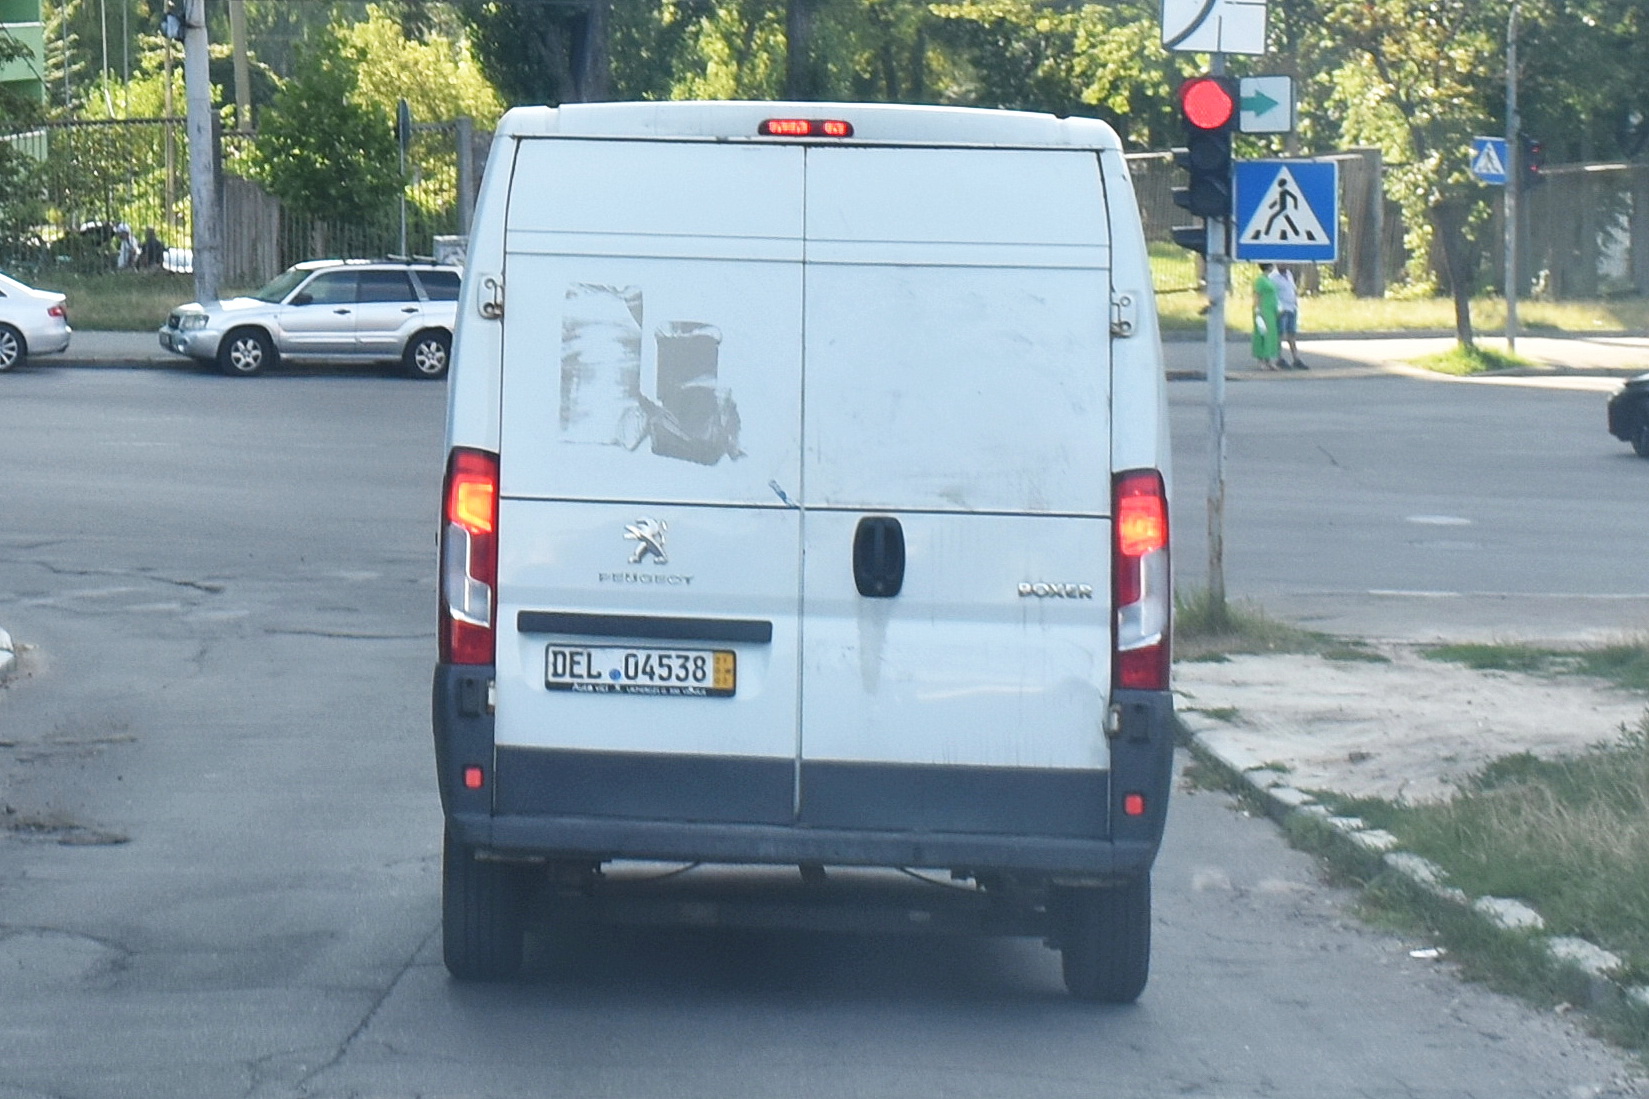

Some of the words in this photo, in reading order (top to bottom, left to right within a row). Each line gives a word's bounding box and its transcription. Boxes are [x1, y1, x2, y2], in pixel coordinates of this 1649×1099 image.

[599, 572, 695, 585] PEUGEOT
[1018, 581, 1093, 599] BOXER
[551, 649, 602, 679] DEL
[623, 652, 707, 683] 04538
